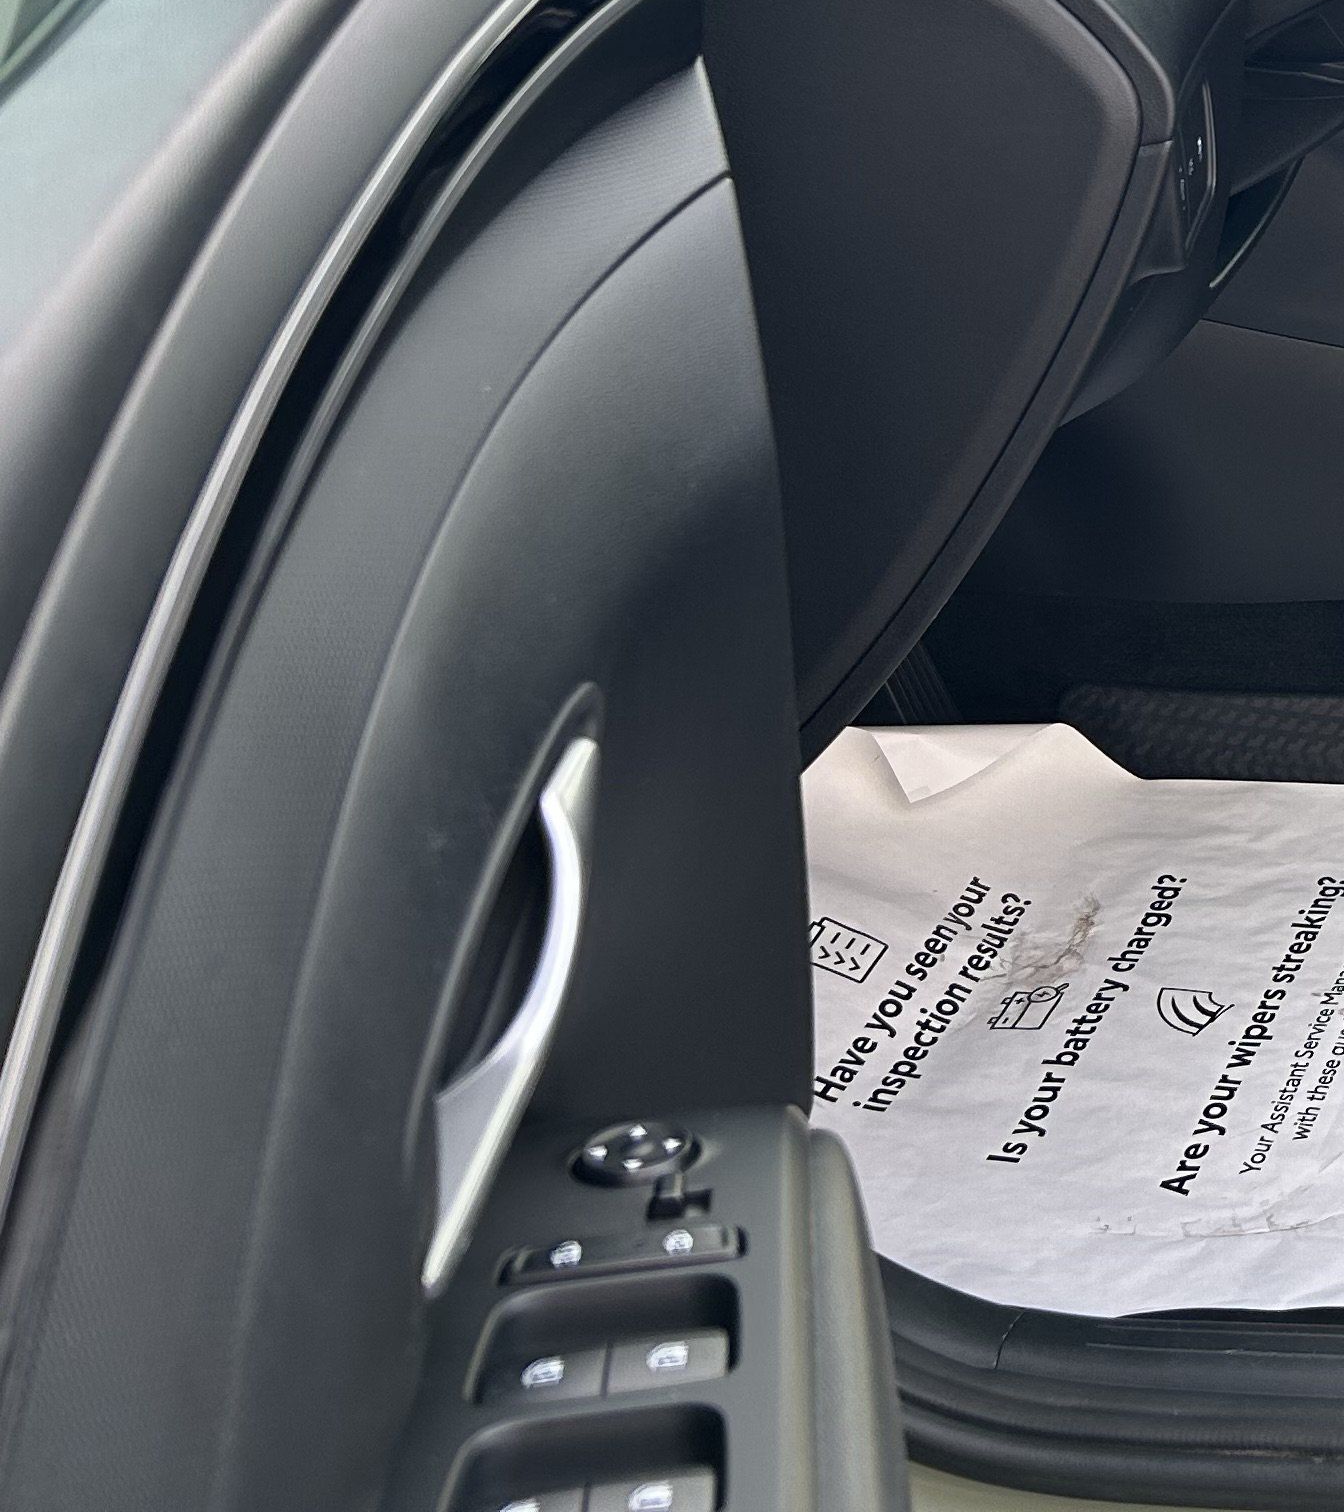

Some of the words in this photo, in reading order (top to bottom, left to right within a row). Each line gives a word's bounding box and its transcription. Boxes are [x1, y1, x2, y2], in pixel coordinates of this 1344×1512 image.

[814, 1036, 878, 1103] Have
[864, 979, 918, 1039] you
[905, 924, 958, 981] seen
[943, 876, 992, 931] your
[852, 982, 973, 1113] inspection
[958, 892, 1032, 983] results?
[986, 1141, 1028, 1164] Is
[1012, 1071, 1066, 1138] your
[1041, 978, 1130, 1067] battery
[1106, 874, 1188, 973] charged?
[1159, 1142, 1210, 1197] Are
[1192, 1073, 1243, 1136] your
[1226, 987, 1287, 1069] wipers
[1239, 1135, 1274, 1175] Your
[1260, 1059, 1310, 1134] Assistant
[1294, 1008, 1335, 1060] Service
[1306, 1058, 1341, 1103] these
[1292, 1106, 1321, 1141] with
